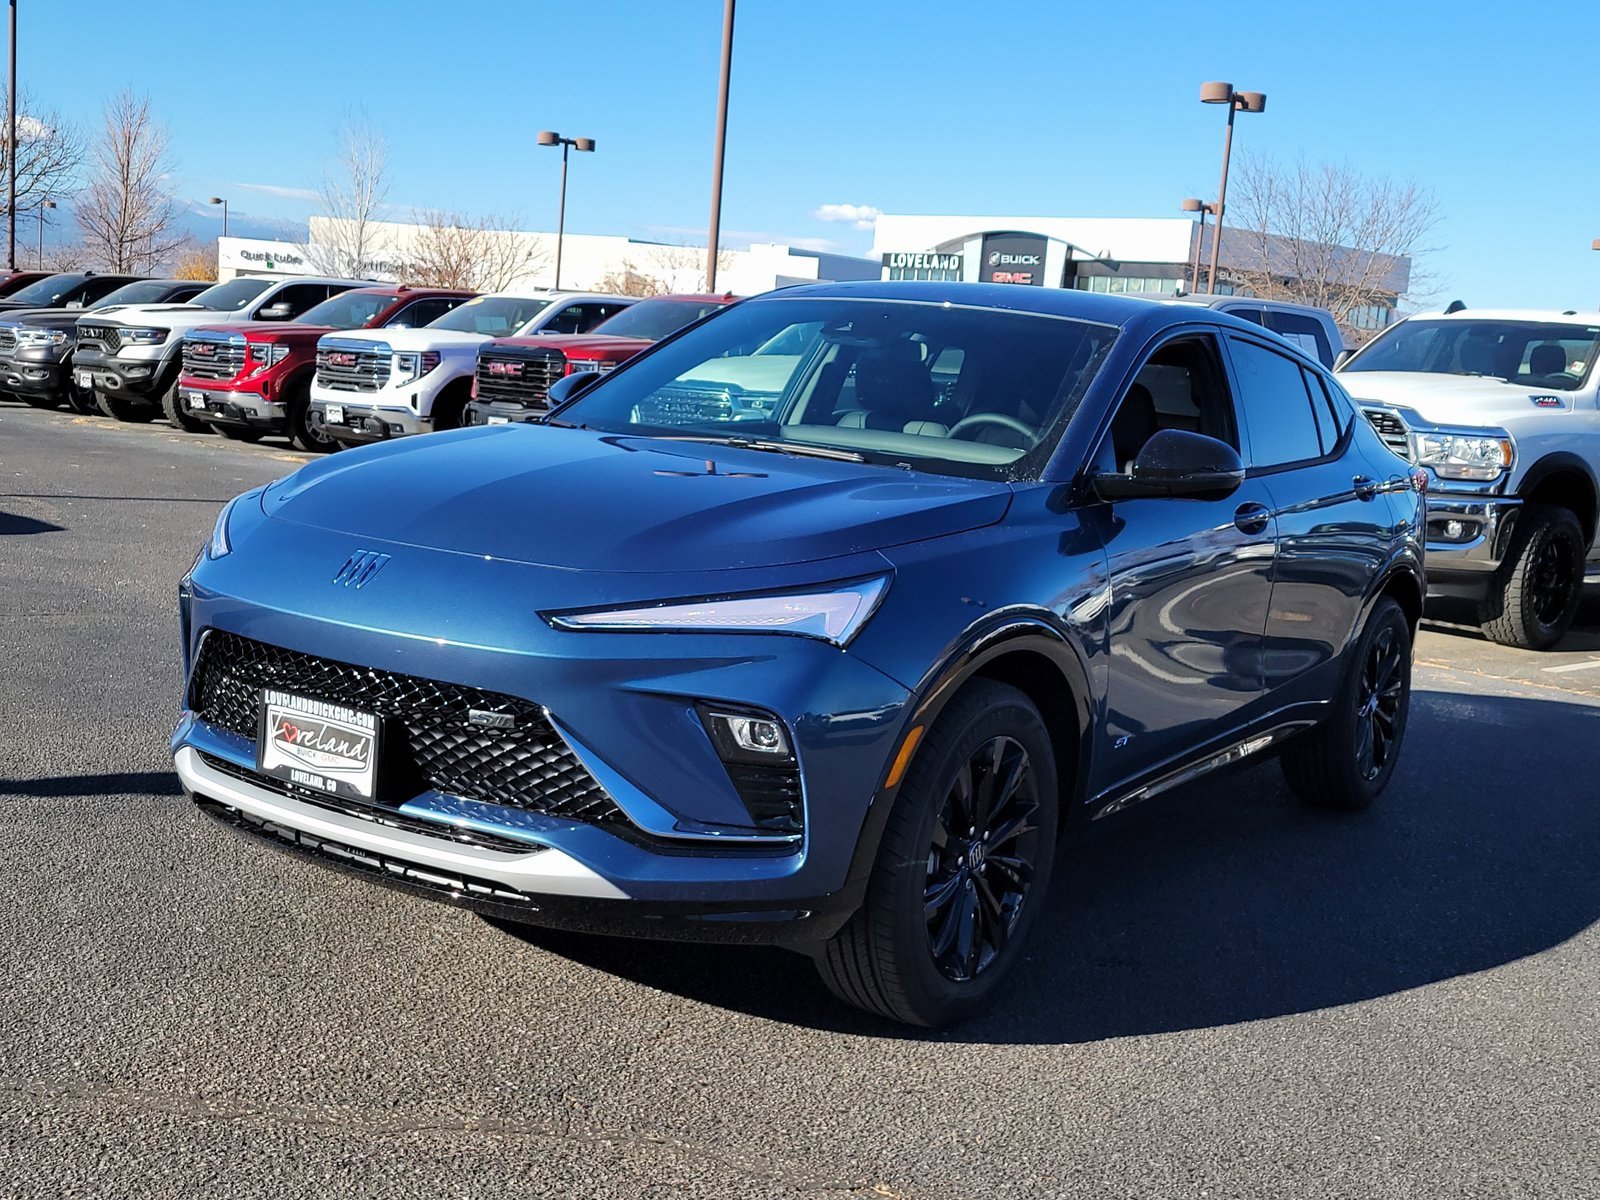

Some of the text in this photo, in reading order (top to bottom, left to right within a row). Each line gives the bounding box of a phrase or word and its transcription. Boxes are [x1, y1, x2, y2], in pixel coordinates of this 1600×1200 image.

[890, 253, 959, 270] LOVELAND
[1000, 254, 1041, 265] BUICK
[992, 271, 1032, 284] GMC
[296, 747, 340, 765] BUICK GMC
[290, 769, 337, 792] LOVELAND, CO
